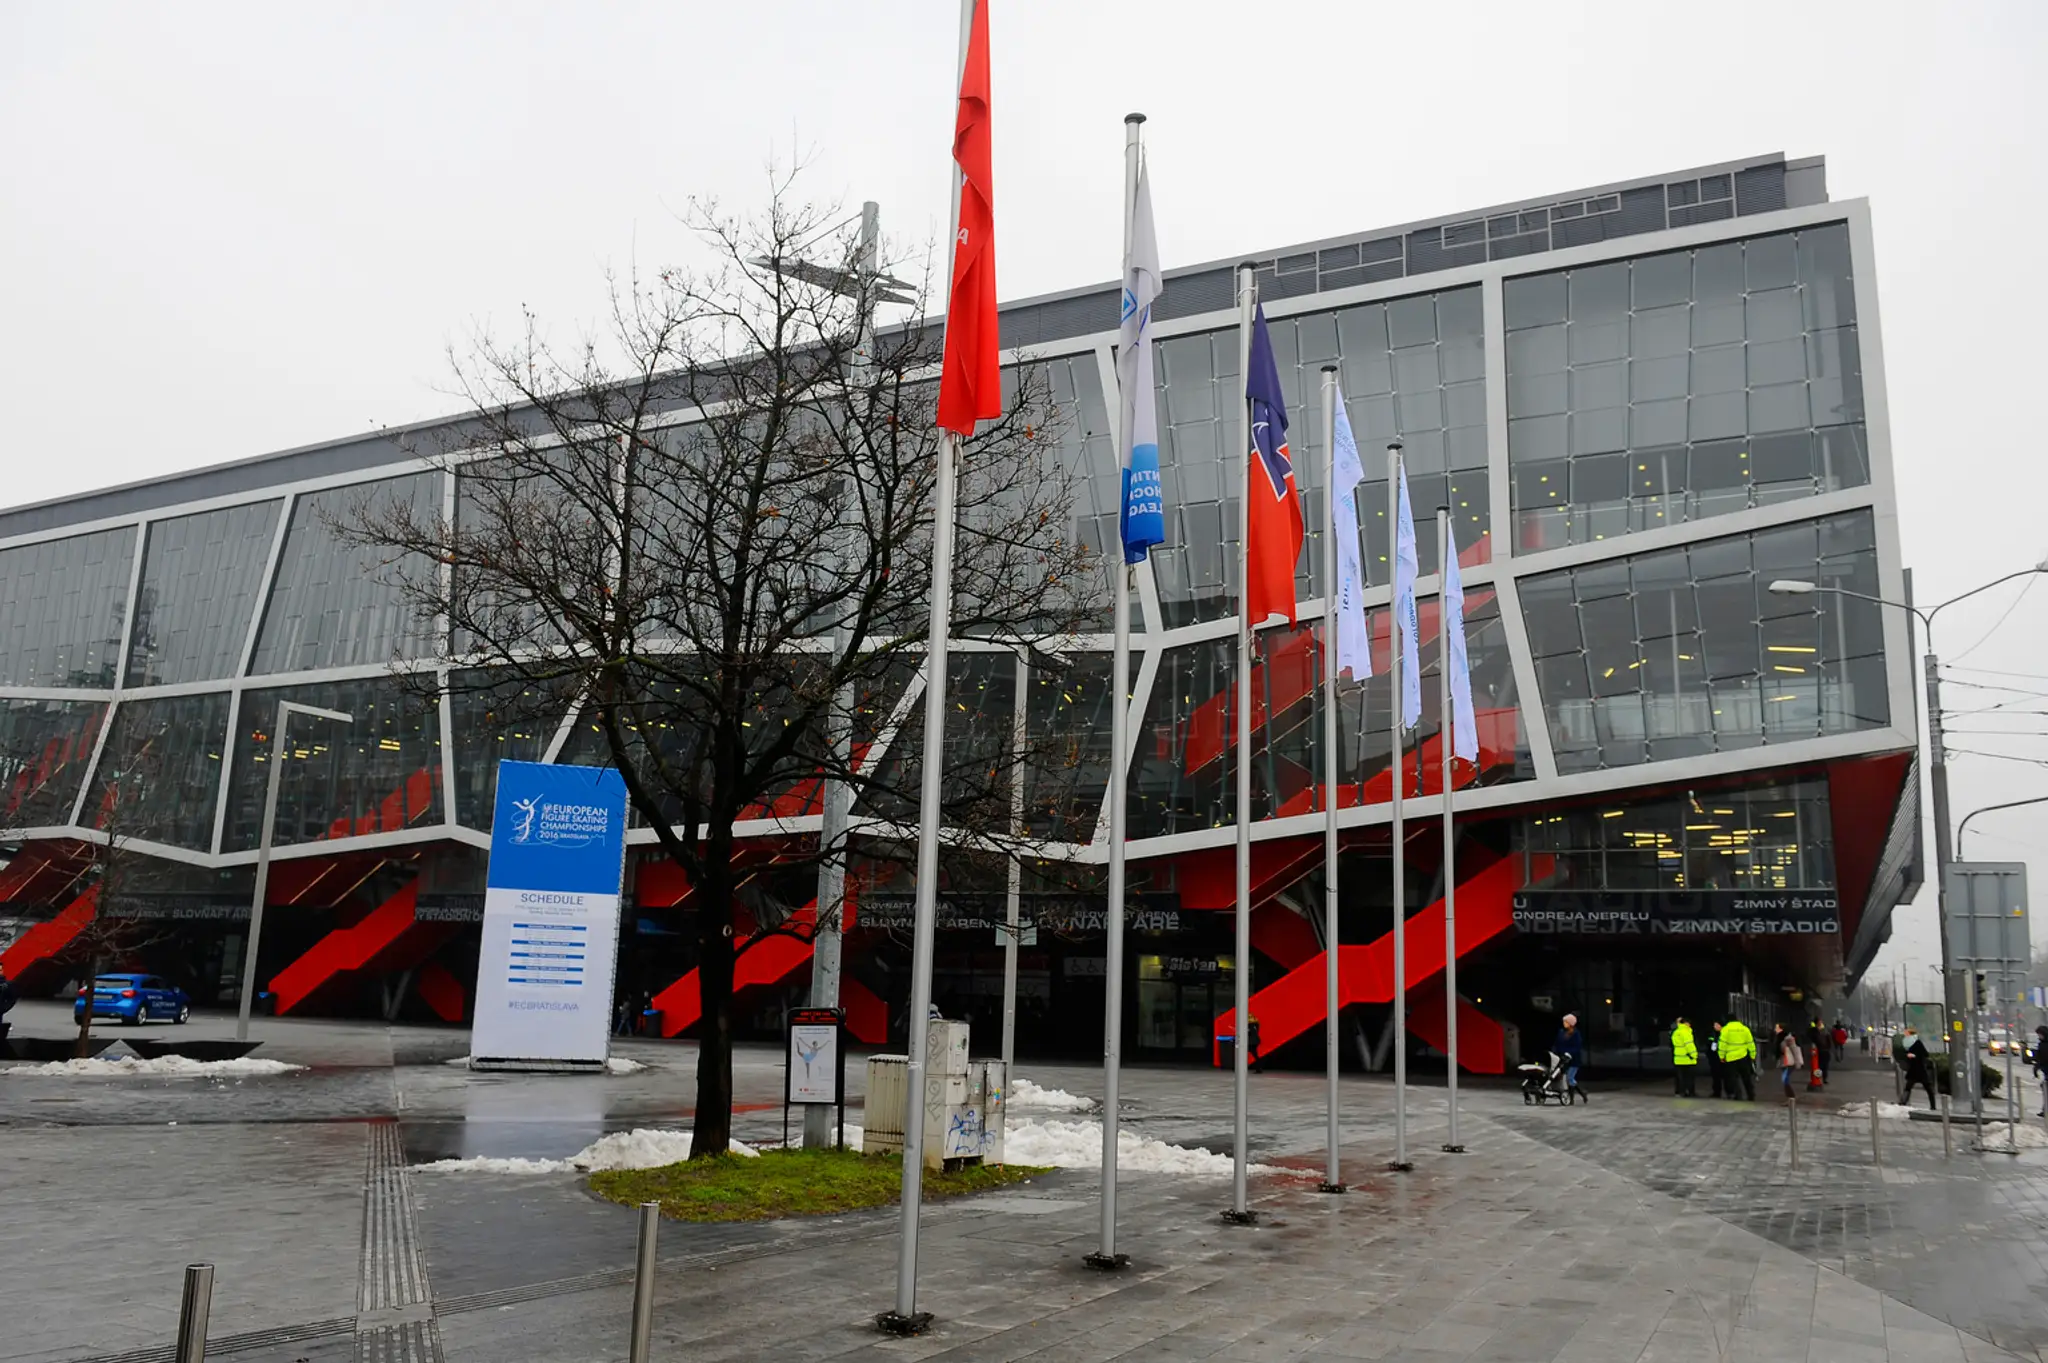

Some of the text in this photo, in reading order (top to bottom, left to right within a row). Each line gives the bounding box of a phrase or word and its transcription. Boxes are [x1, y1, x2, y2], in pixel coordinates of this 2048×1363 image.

[553, 804, 608, 817] EUROPEAN
[541, 813, 608, 825] FIGURE SKATING
[540, 821, 608, 833] CHAMPIONSHIPS
[540, 830, 559, 839] 2016
[520, 892, 585, 906] SCHEDULE
[1733, 897, 1788, 909] ZIMNÝ
[1791, 897, 1837, 909] ŠTAD
[1512, 911, 1650, 921] ONDREJA NEPELU
[945, 918, 995, 929] AREN
[1668, 917, 1745, 933] ZIMNÝ
[1750, 917, 1839, 934] ŠTADIÓ
